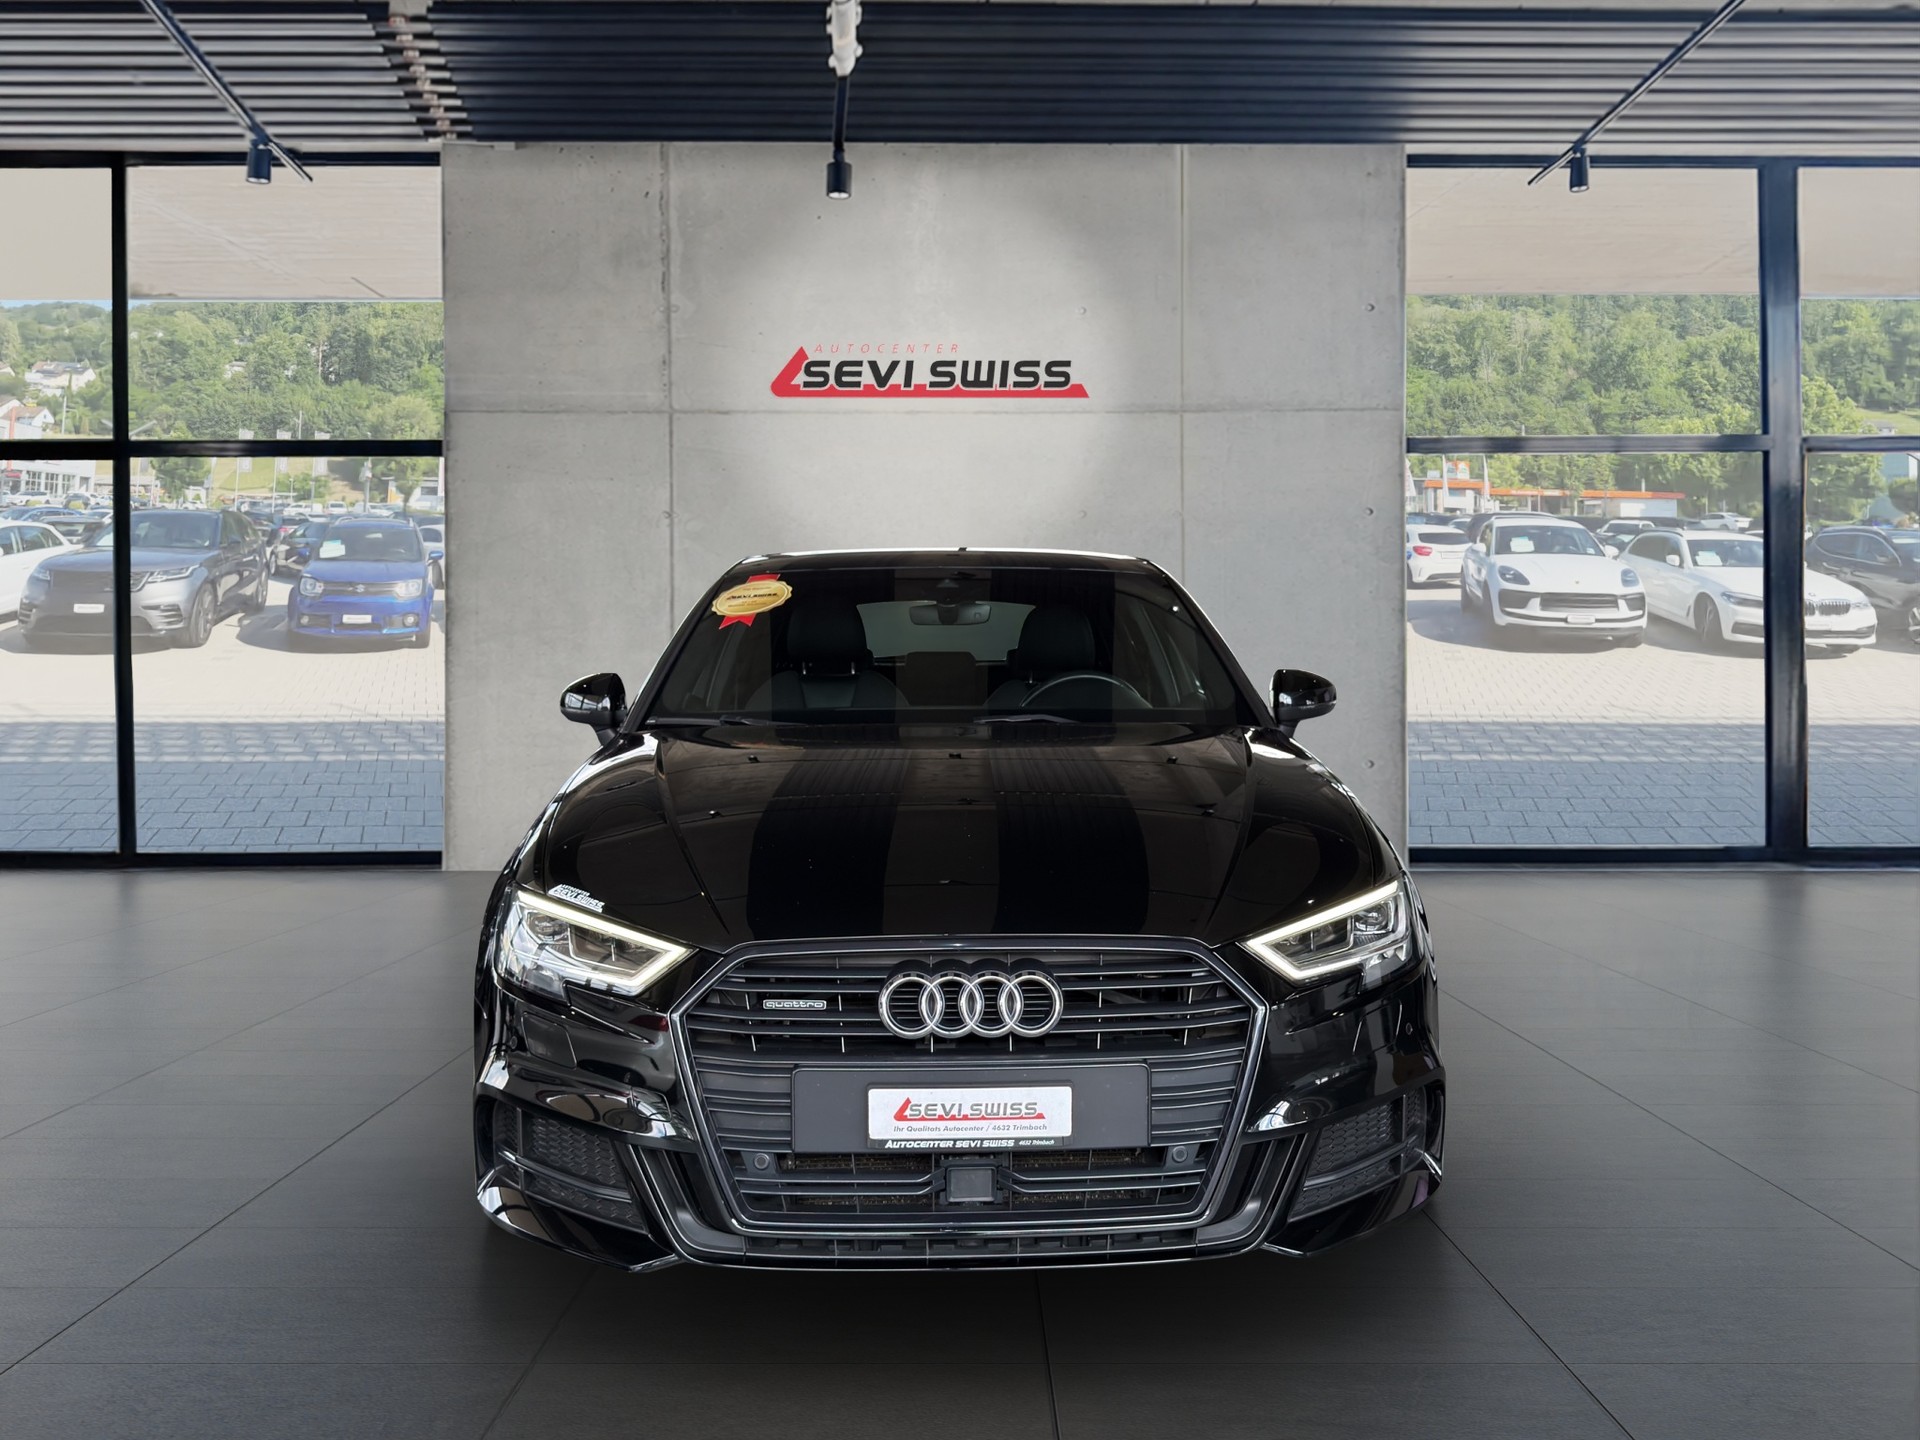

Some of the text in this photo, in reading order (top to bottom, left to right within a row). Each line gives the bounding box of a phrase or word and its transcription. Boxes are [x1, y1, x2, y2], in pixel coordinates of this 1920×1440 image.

[814, 343, 959, 353] AUTOCENTER
[803, 360, 1072, 388] SEVI SWISS
[909, 1102, 1038, 1117] SEVI SWISS
[1013, 1123, 1048, 1131] Trimbach
[955, 1140, 981, 1148] SEVI
[982, 1139, 1015, 1148] SWISS
